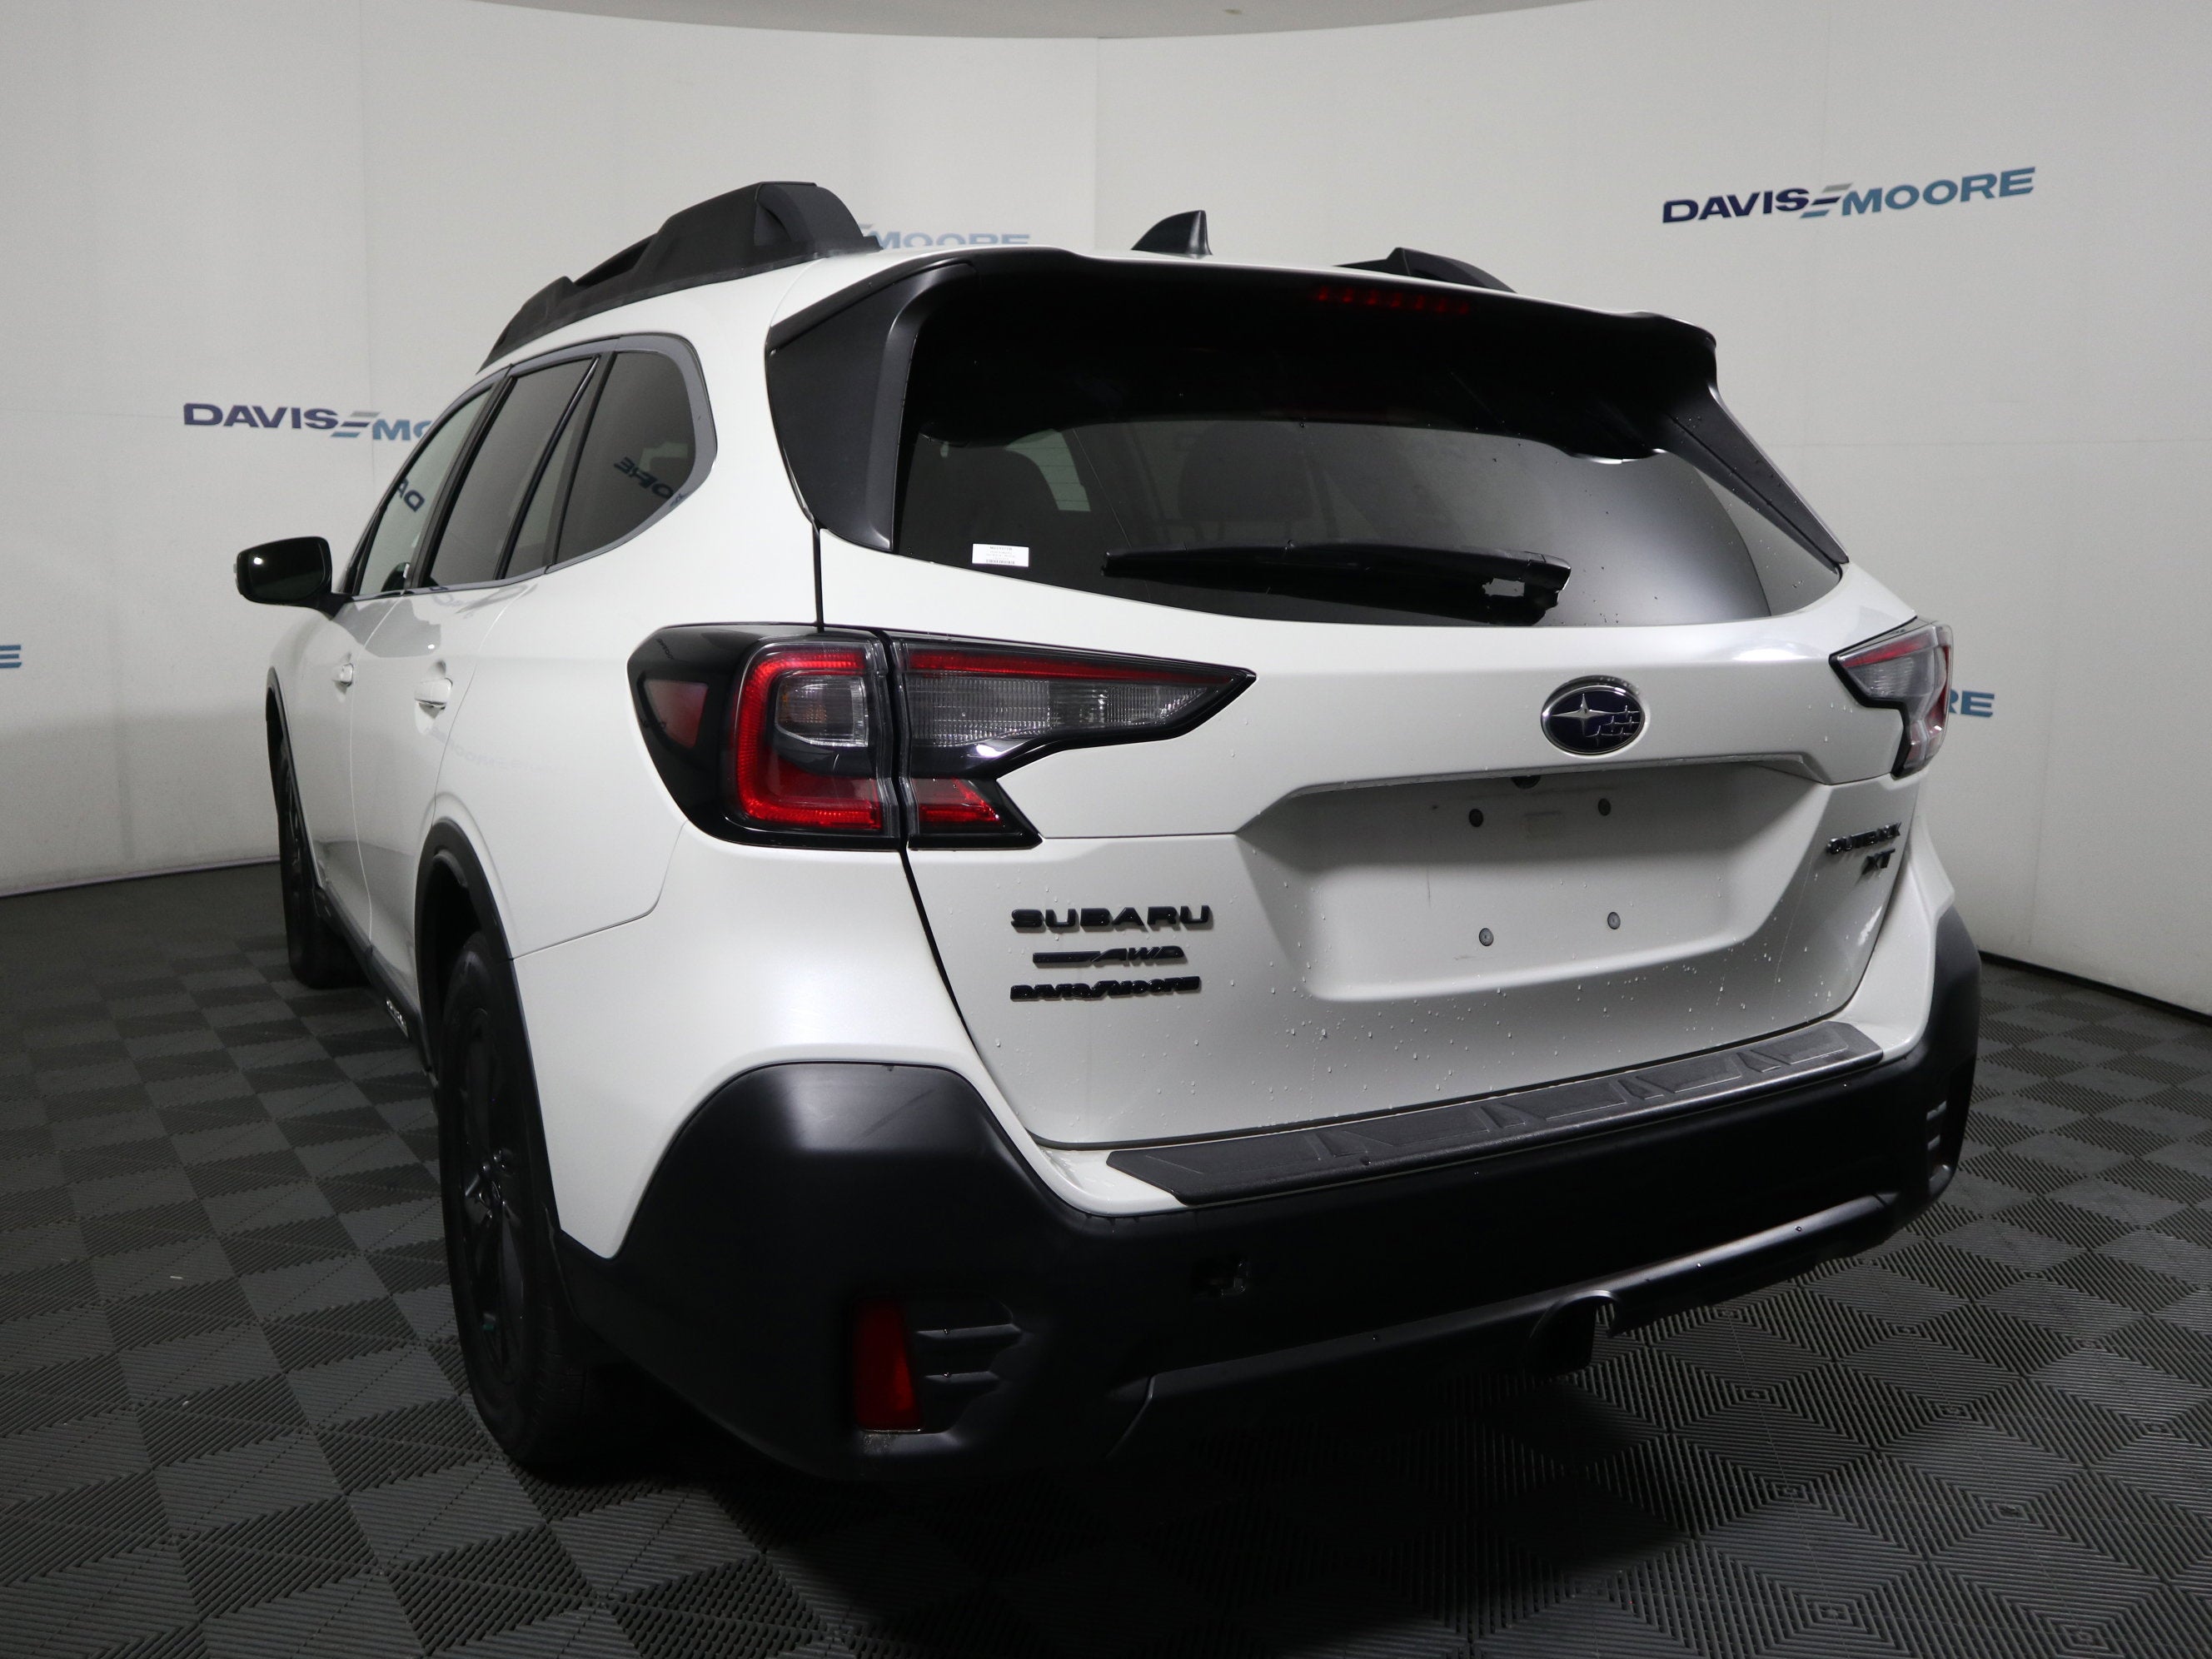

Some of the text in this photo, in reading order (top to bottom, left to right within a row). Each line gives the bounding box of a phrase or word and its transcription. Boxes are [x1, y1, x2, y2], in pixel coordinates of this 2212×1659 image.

[1662, 167, 2035, 223] DAVIS MOORE
[183, 403, 339, 429] DAVIS
[1010, 904, 1213, 929] SUBARU
